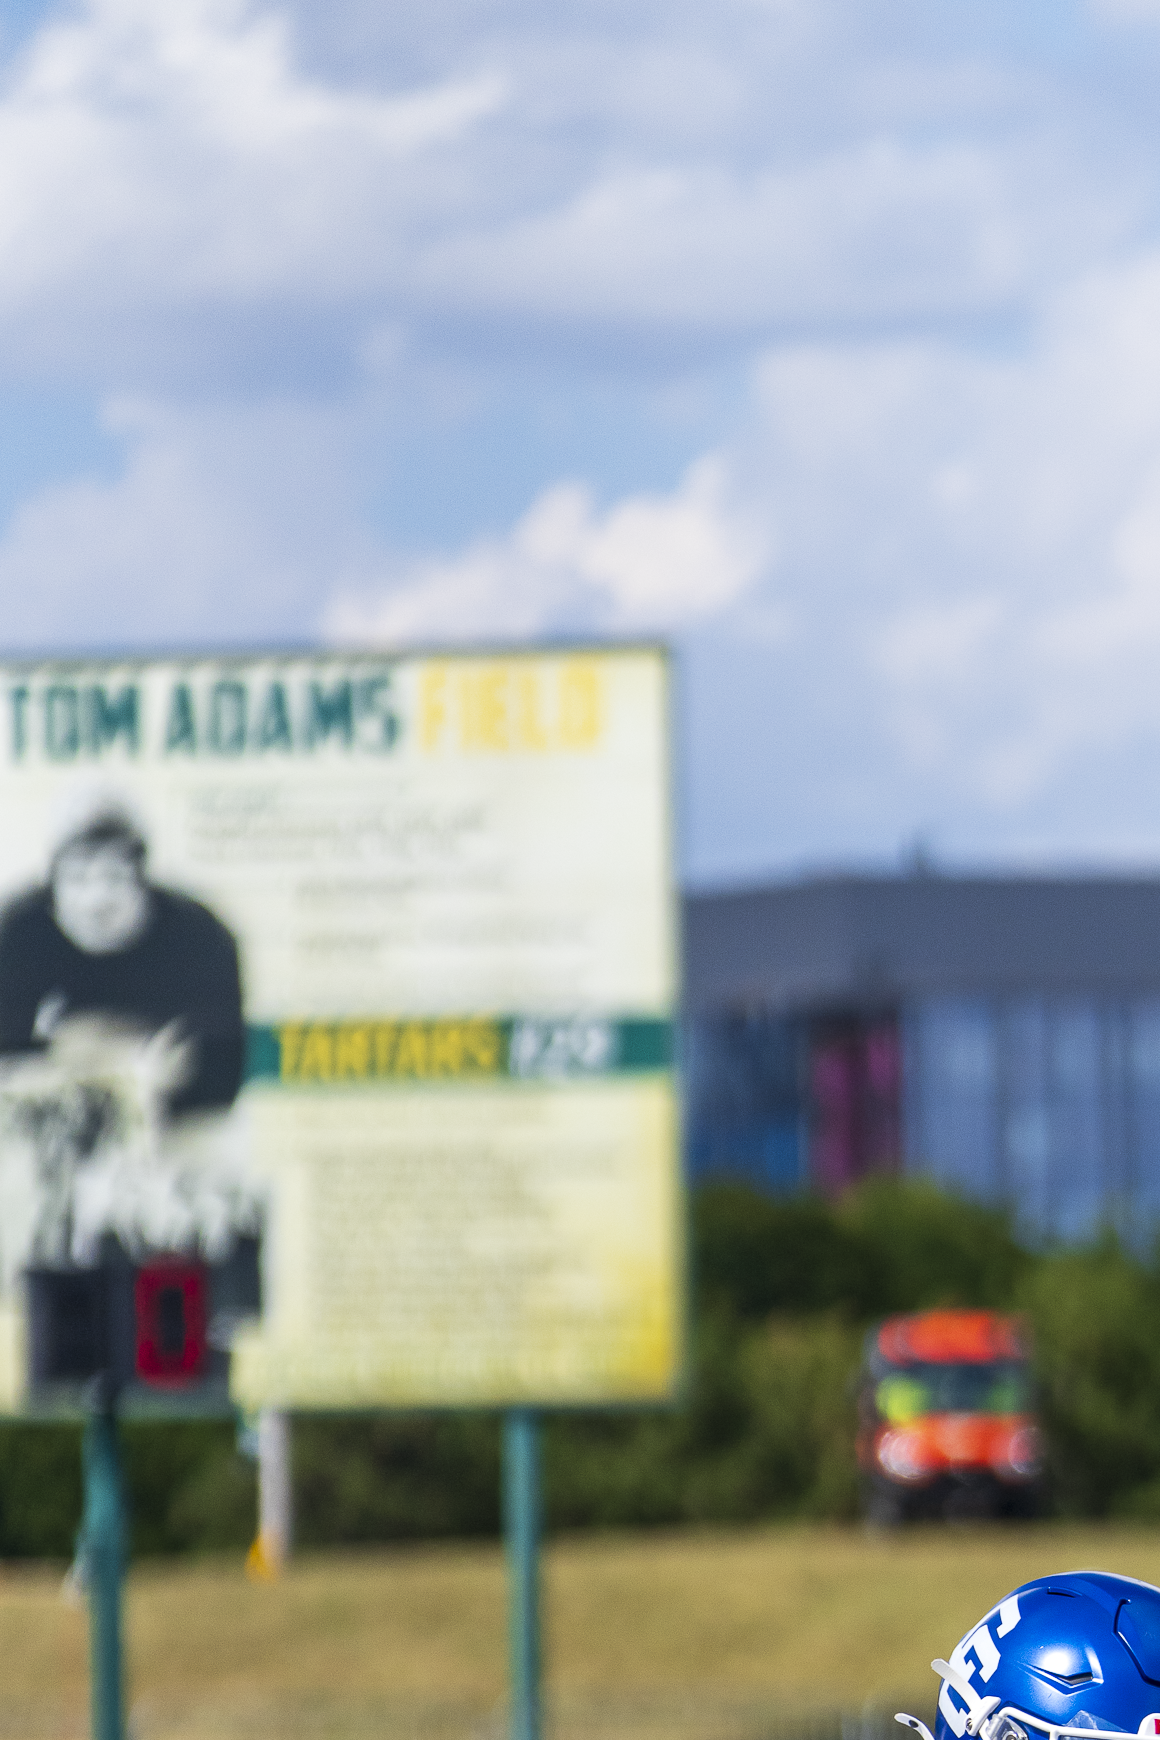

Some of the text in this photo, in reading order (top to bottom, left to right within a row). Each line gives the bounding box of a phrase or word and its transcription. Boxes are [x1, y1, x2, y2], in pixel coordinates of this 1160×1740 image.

[7, 659, 605, 764] TOM ADAMS FIELD
